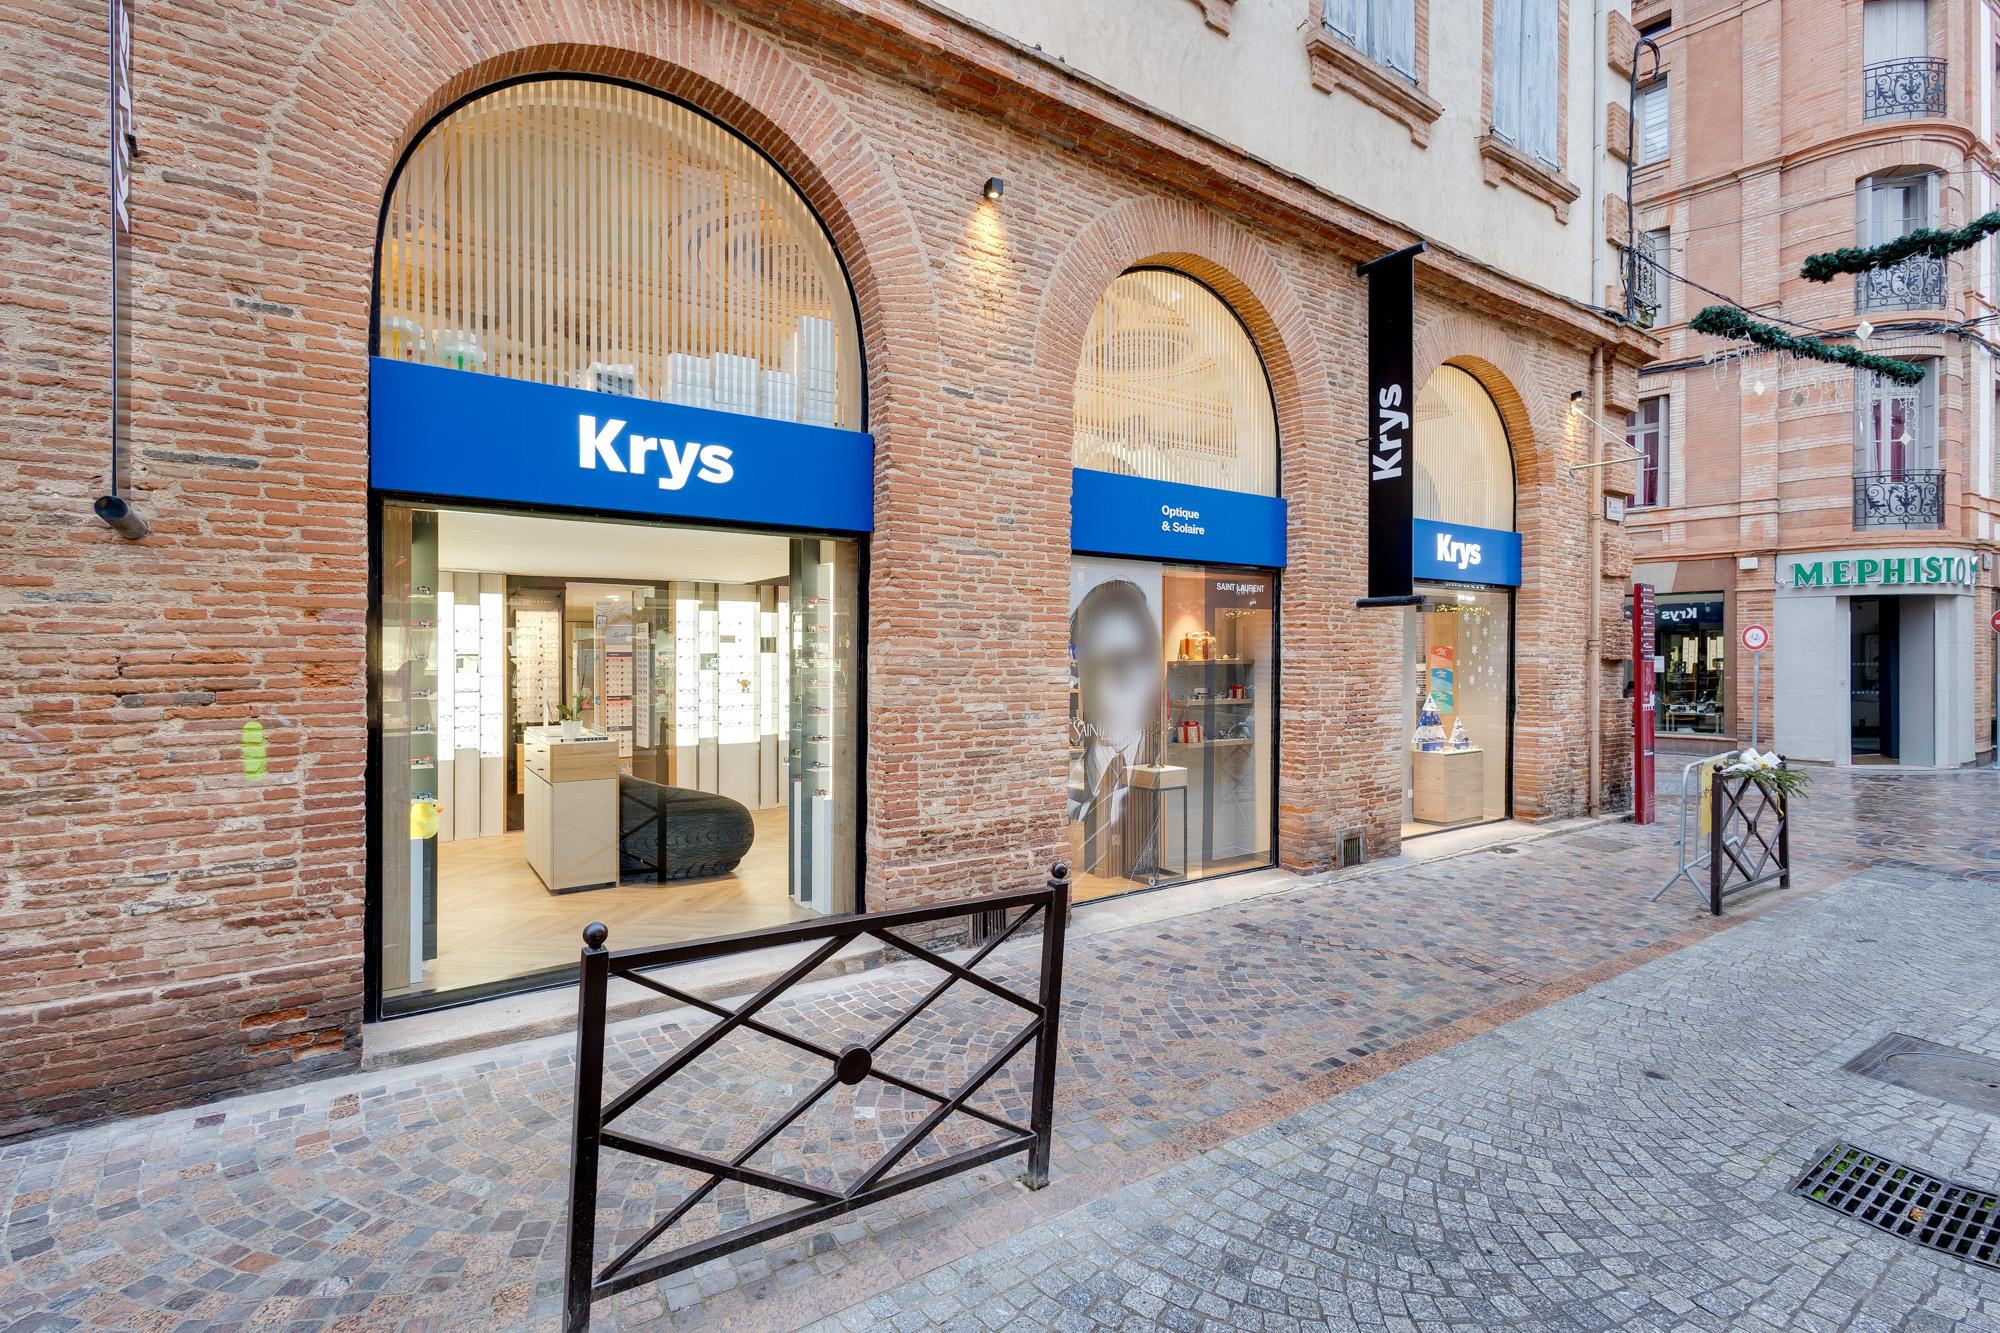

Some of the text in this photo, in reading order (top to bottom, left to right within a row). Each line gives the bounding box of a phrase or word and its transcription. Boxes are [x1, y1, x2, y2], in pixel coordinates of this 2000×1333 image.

[1372, 383, 1409, 481] Krys
[579, 414, 734, 491] Krys
[1161, 505, 1200, 520] Optique
[1161, 521, 1205, 535] & Solaire
[1437, 532, 1481, 570] Krys
[1793, 556, 1966, 587] MEPHISTO
[1216, 582, 1265, 593] SAINT LAURENT
